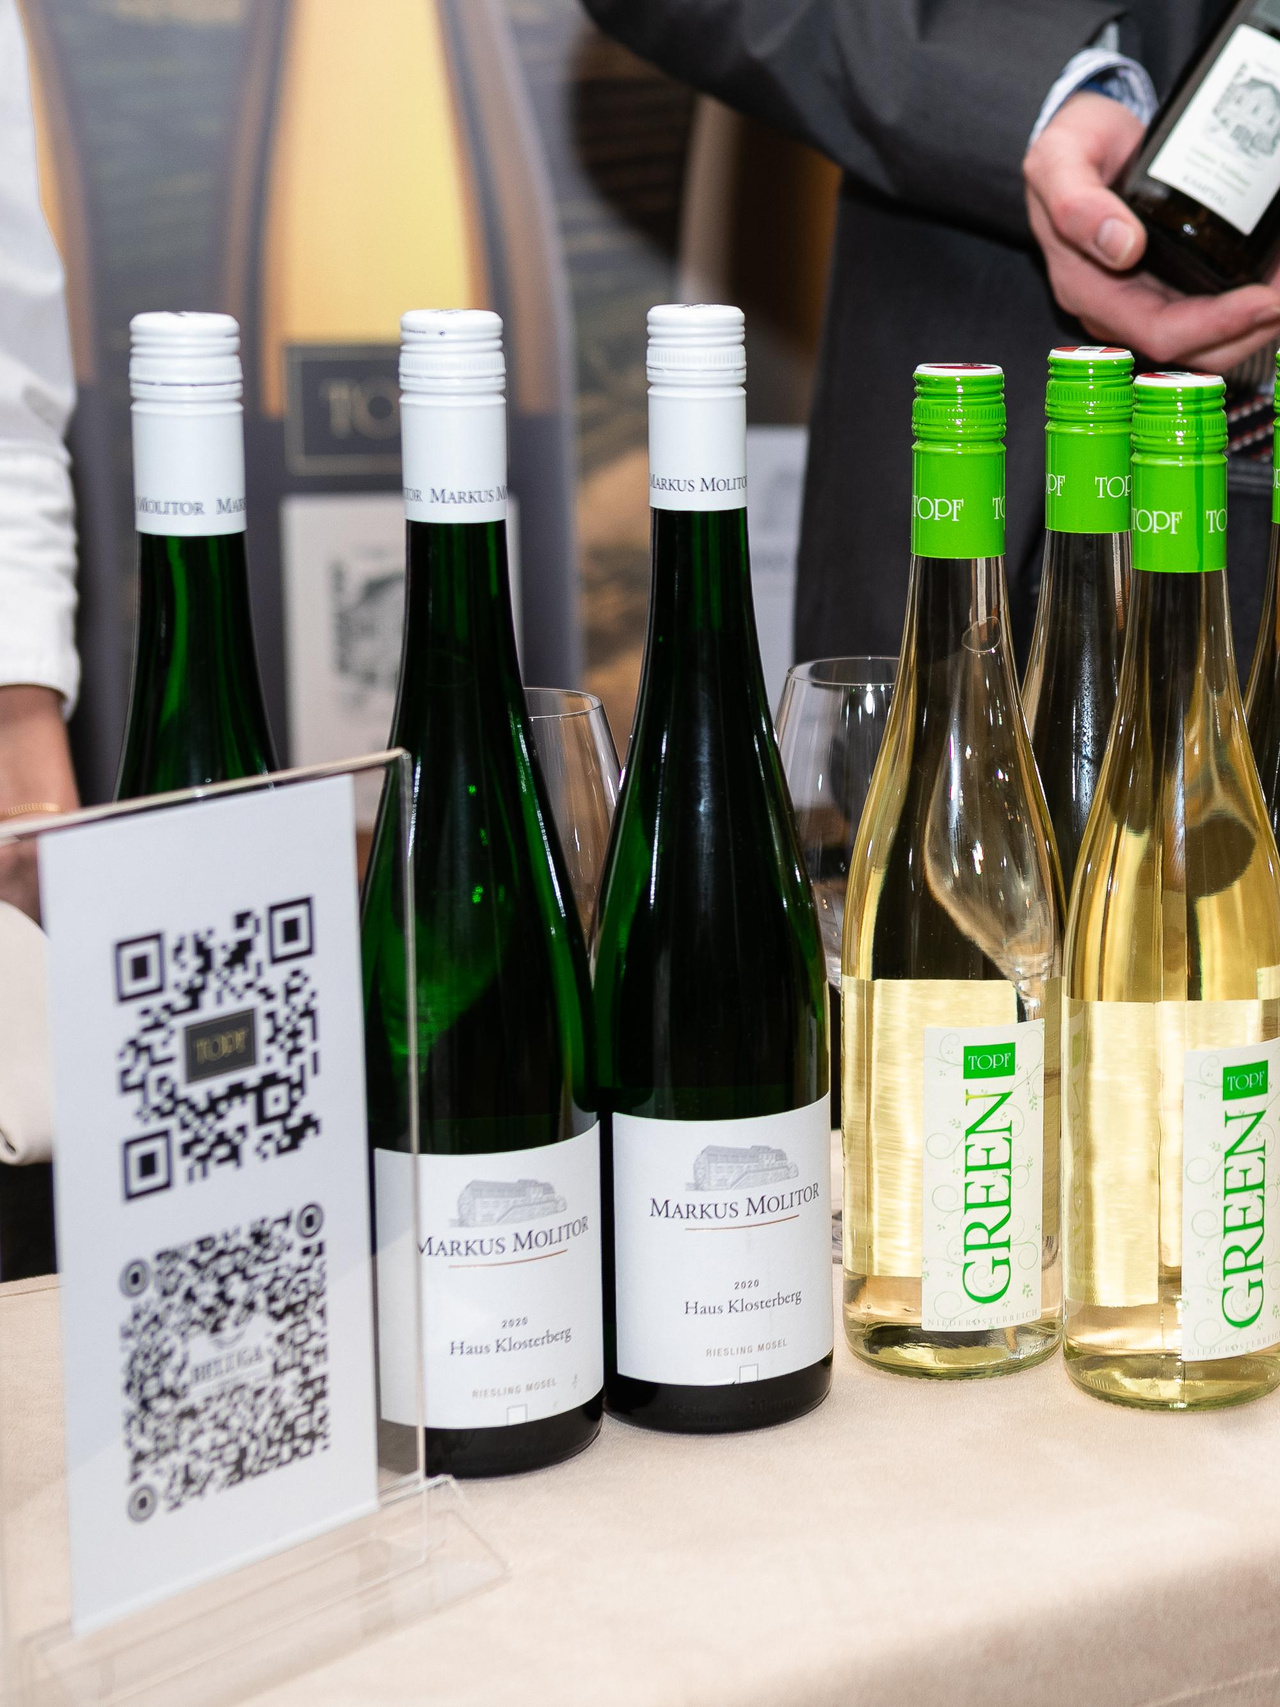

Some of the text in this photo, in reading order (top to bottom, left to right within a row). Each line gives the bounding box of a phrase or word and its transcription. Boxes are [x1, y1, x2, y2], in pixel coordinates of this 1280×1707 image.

[430, 487, 495, 504] MARKUS
[913, 494, 964, 522] TOPF
[1132, 507, 1183, 535] TOPF
[967, 1052, 1012, 1072] TOPF
[1226, 1071, 1264, 1091] TOPF
[649, 1181, 820, 1221] MARKUS MOLITOR
[962, 1089, 1014, 1304] GREEN
[1221, 1109, 1268, 1329] GREEN
[417, 1215, 590, 1258] MARKUS MOLITOR
[734, 1278, 760, 1291] 2020
[684, 1290, 803, 1316] Haus Klosterberg
[501, 1316, 529, 1329] 2020
[450, 1326, 573, 1356] Haus Klosterberg
[706, 1338, 788, 1358] RIESLING MOSEL
[472, 1377, 558, 1399] RIESLING MOSEL
